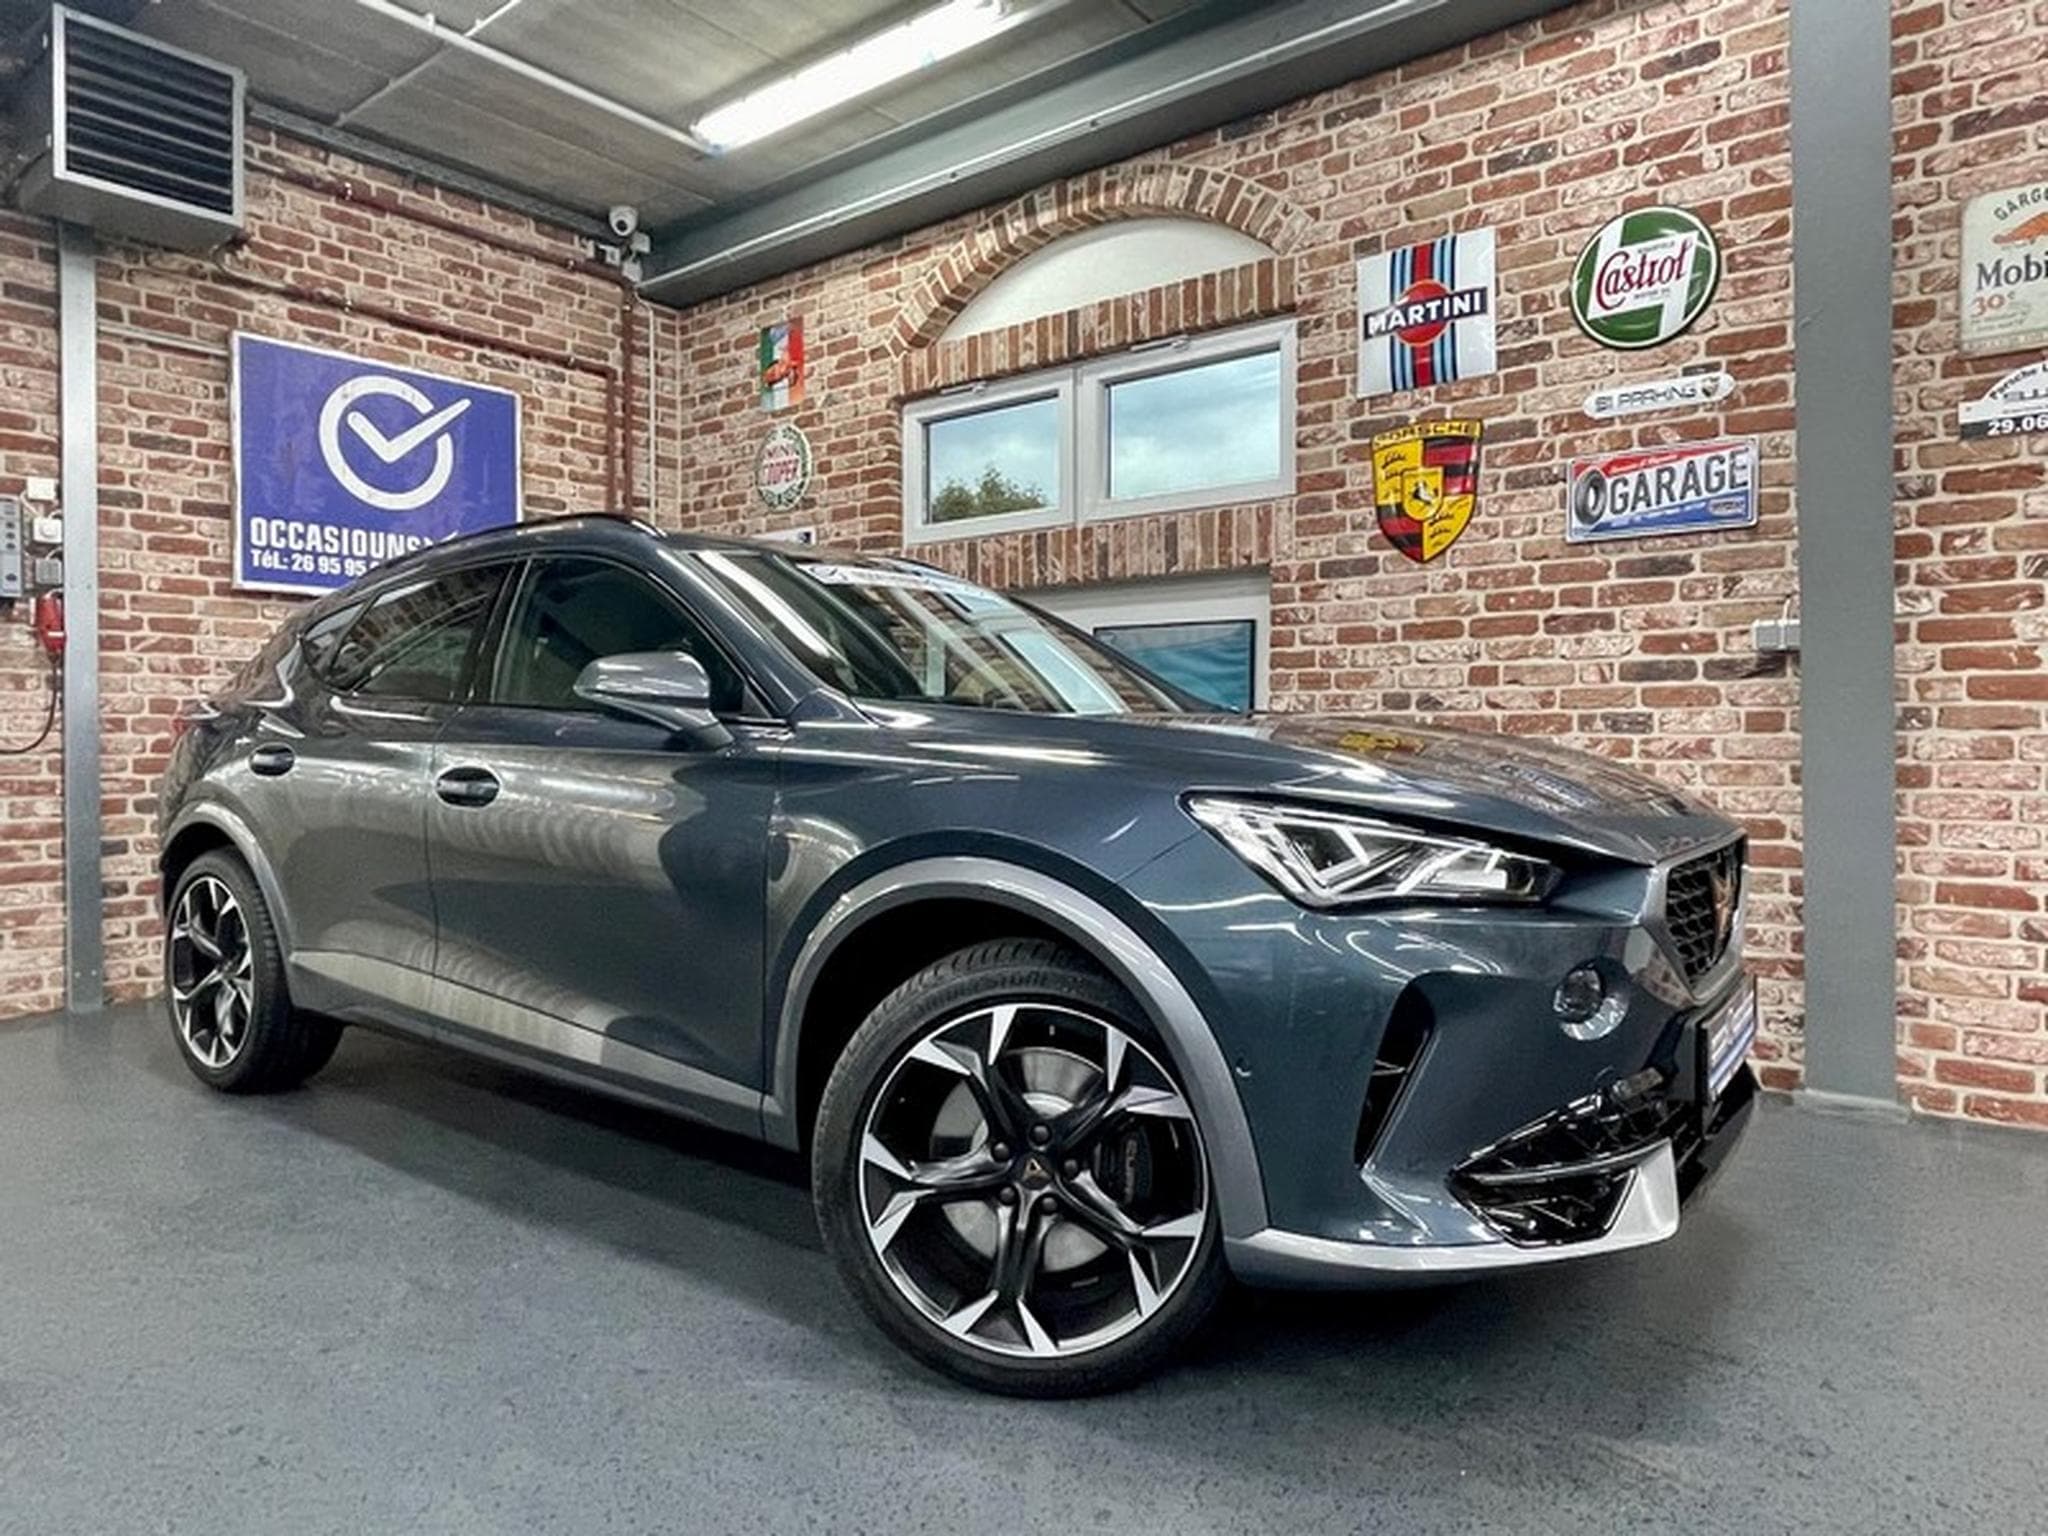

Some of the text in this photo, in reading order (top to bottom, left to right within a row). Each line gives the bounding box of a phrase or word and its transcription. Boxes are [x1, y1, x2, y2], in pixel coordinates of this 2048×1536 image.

[1595, 239, 1693, 311] Castrol
[1368, 291, 1481, 335] MARTINI
[1609, 448, 1750, 515] GARAGE
[250, 516, 434, 560] OCCASIOUNS
[317, 555, 341, 575] 95
